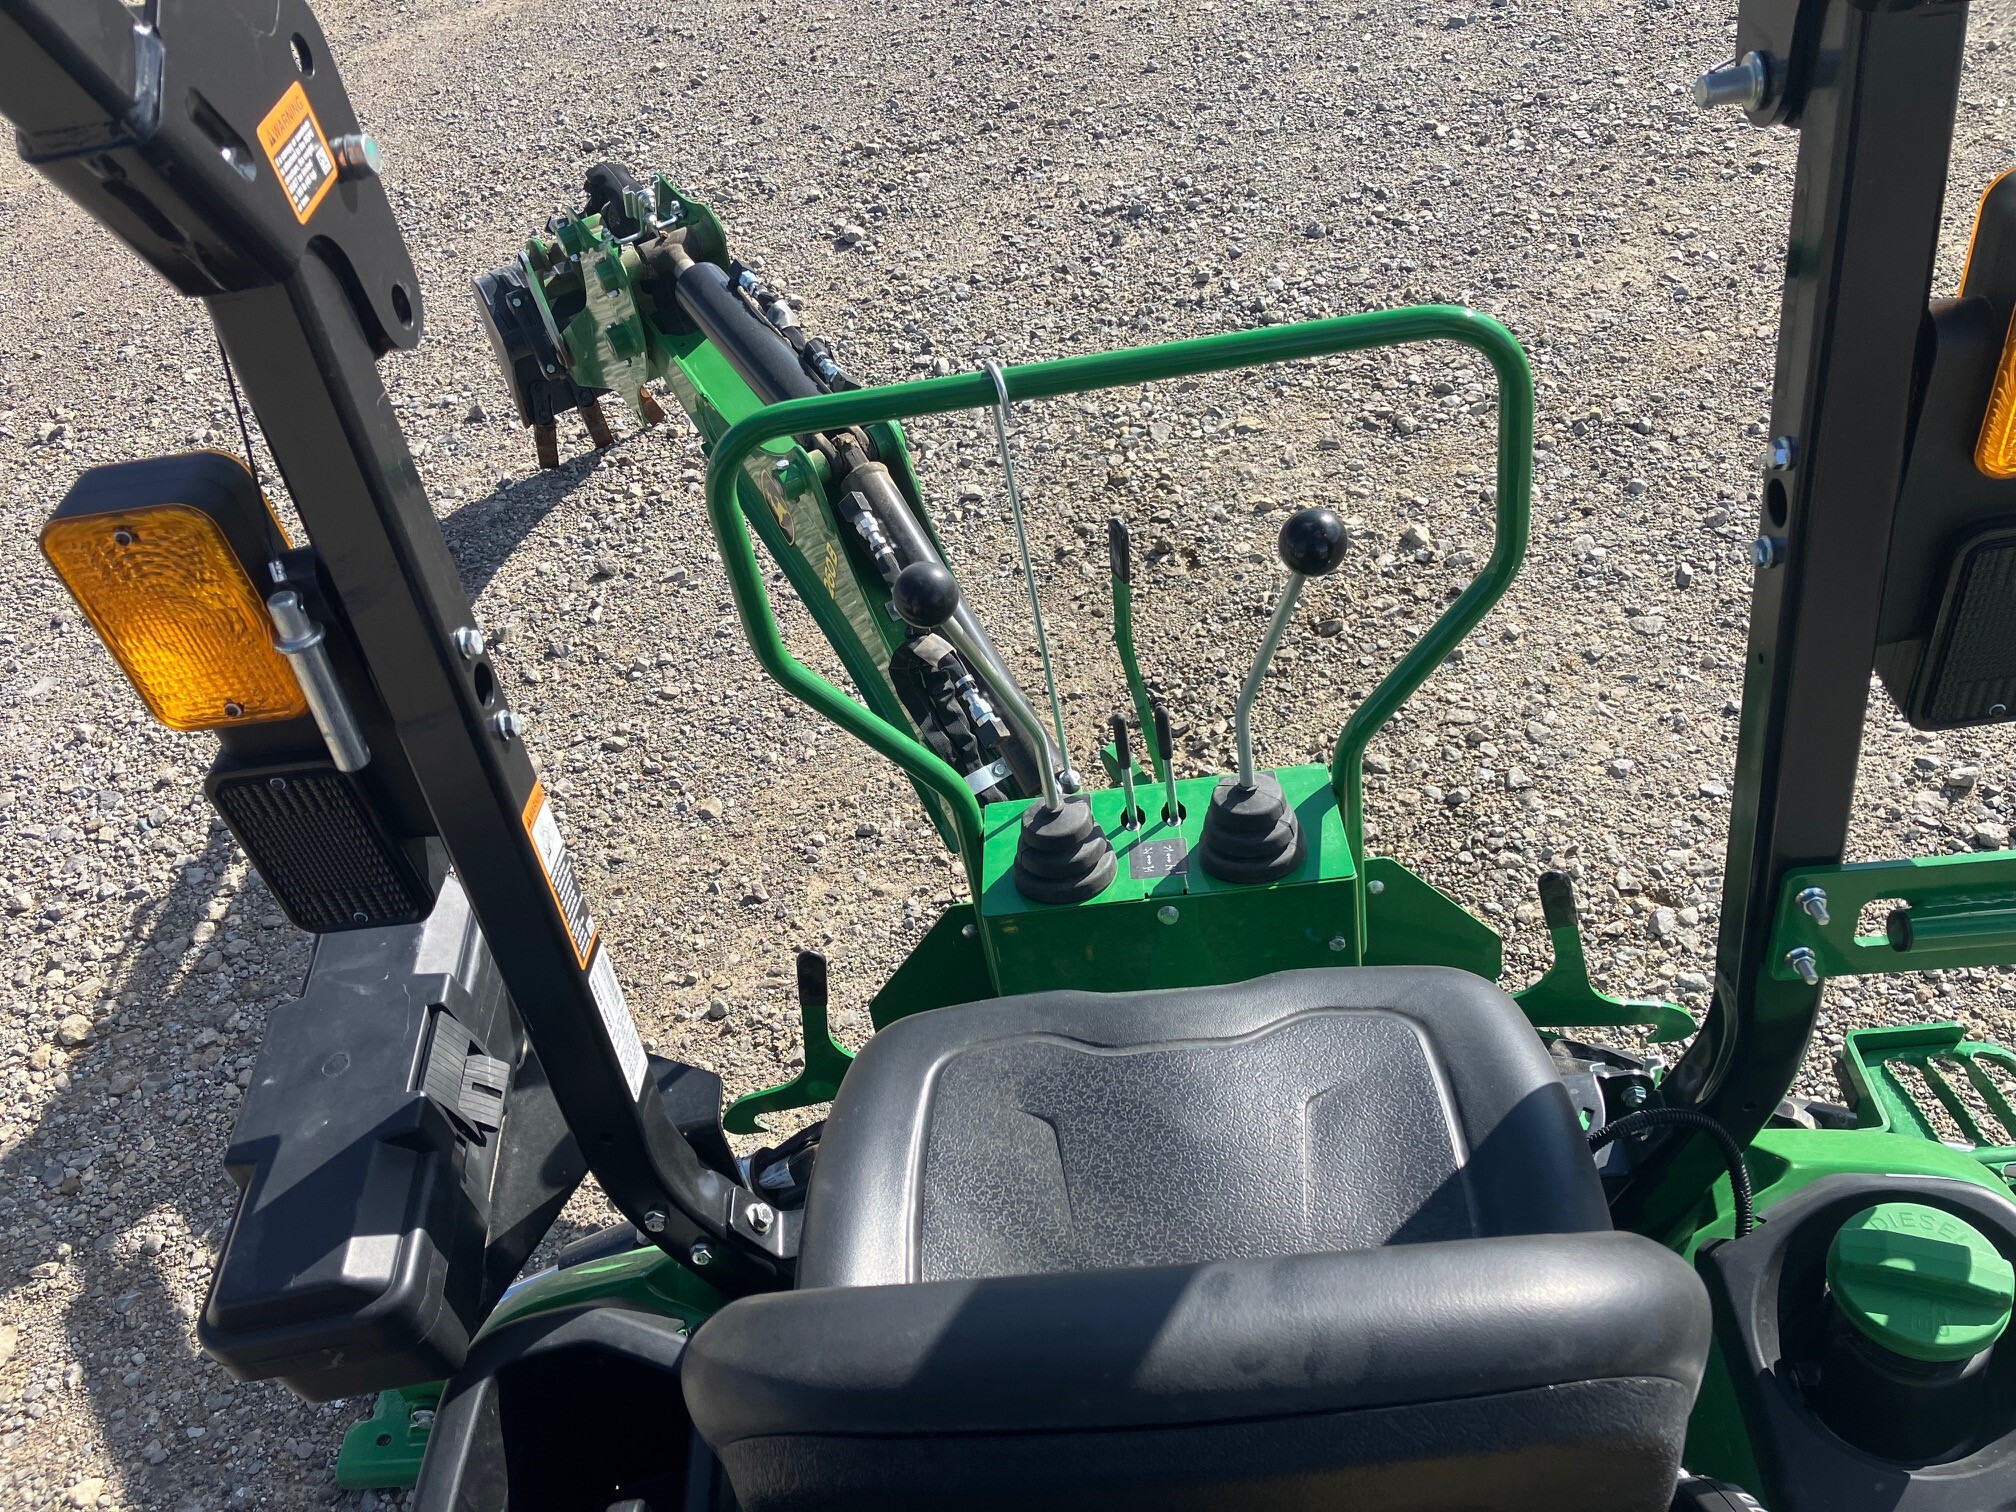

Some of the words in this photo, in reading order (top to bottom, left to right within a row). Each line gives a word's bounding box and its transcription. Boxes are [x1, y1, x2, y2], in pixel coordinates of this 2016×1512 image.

[273, 97, 305, 138] WARNING
[823, 542, 838, 599] 260B
[1869, 1212, 1969, 1244] DIESEL
